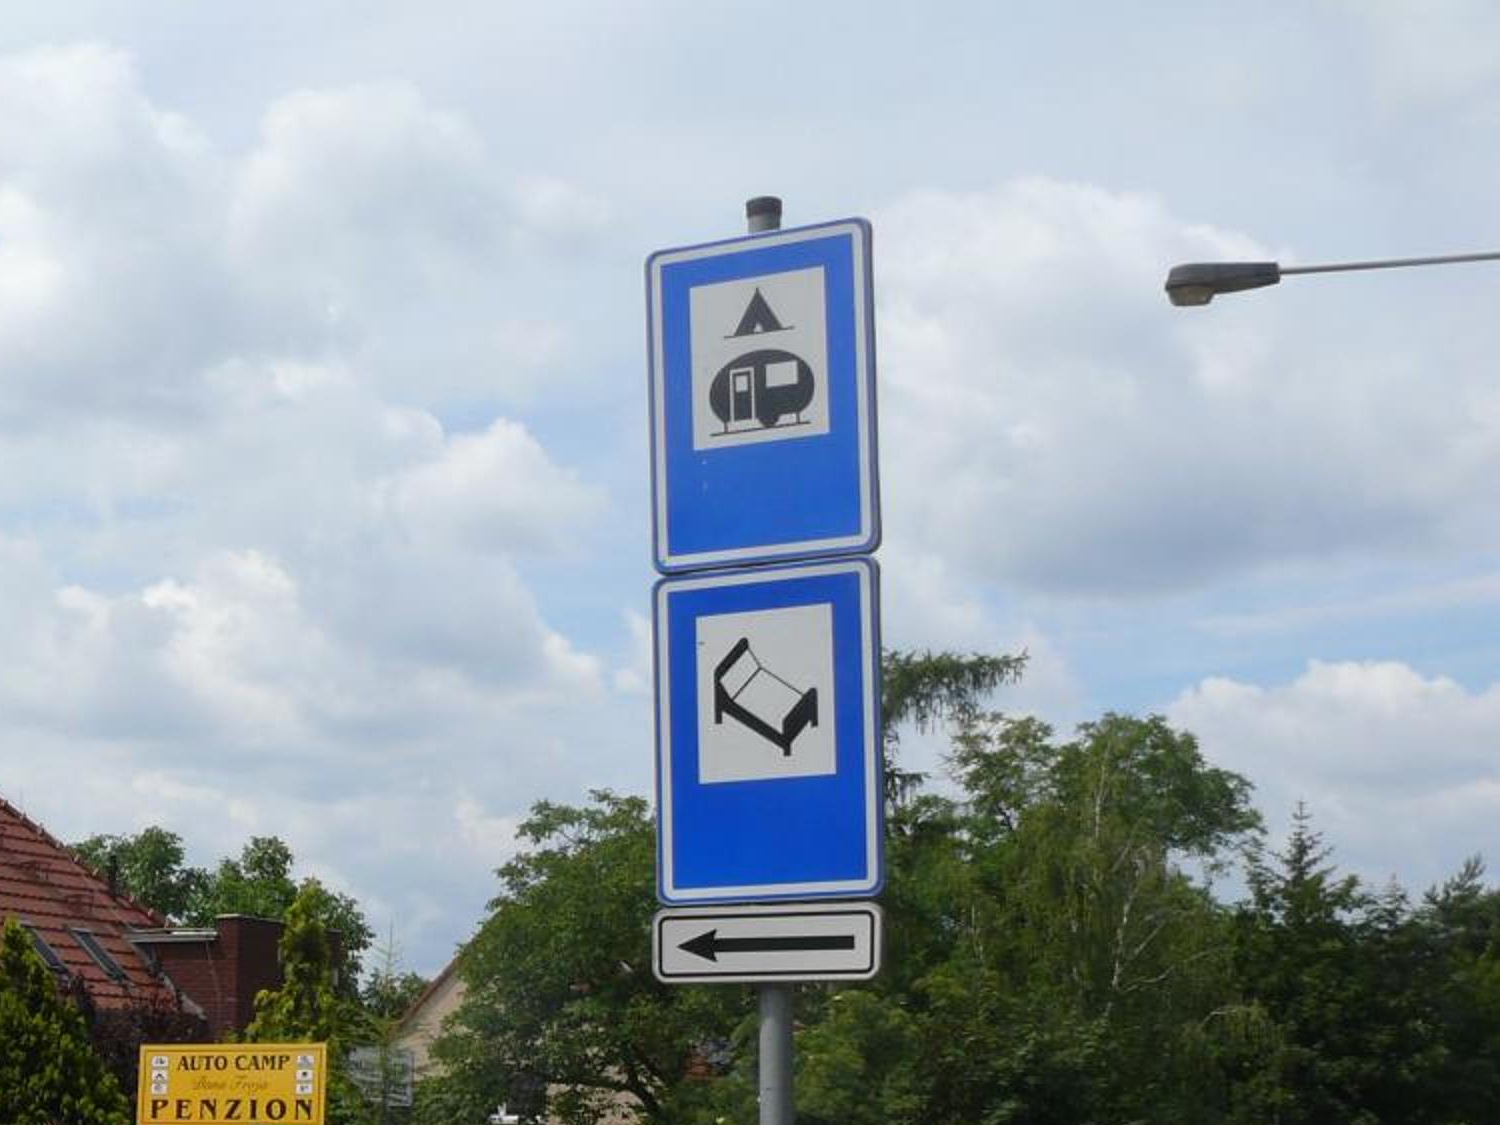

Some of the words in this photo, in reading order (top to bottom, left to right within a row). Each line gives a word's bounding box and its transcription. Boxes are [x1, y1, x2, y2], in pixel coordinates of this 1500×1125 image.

[177, 1055, 228, 1071] AUTO
[235, 1055, 290, 1071] CAMP
[151, 1099, 313, 1120] PENZION
